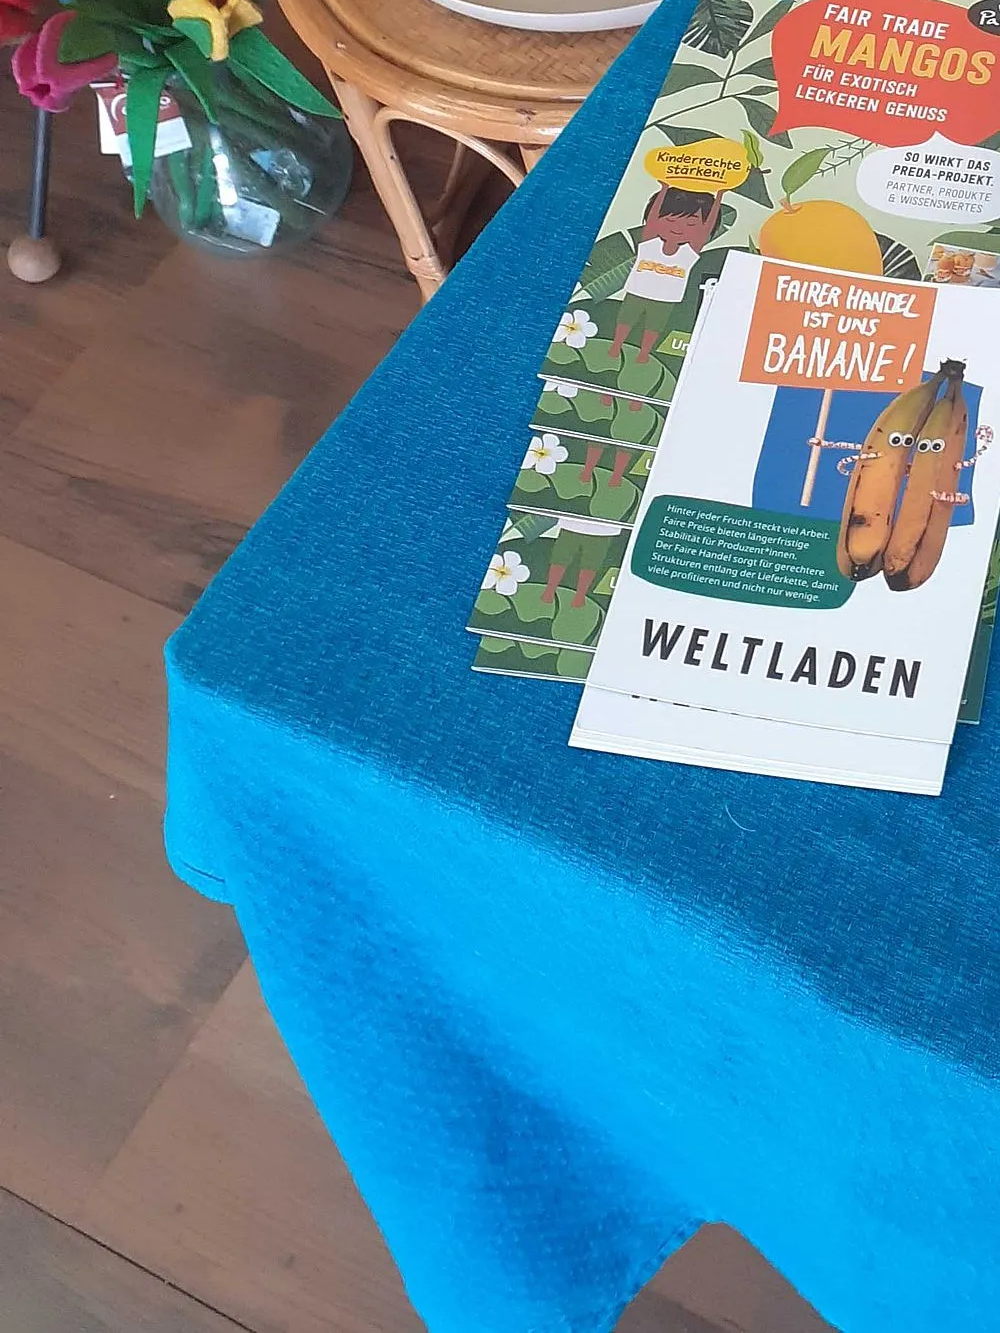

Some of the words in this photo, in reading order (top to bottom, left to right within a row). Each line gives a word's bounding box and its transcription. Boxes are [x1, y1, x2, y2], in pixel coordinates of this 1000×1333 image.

[824, 3, 872, 28] FAIR
[882, 13, 950, 40] TRADE
[809, 24, 997, 86] MANGOS
[802, 64, 835, 83] FÜR
[840, 72, 918, 98] EXOTISCH
[795, 84, 881, 113] LECKEREN
[885, 101, 949, 123] GENUSS
[656, 151, 742, 171] Kinderrechte
[666, 164, 726, 180] stärken!
[892, 165, 995, 188] PREDA-PROJEKT.
[904, 152, 920, 163] SO
[924, 154, 964, 168] WIRKT
[967, 159, 992, 172] DAS
[886, 180, 936, 196] PARTNER,
[938, 187, 993, 202] PRODUKTE
[888, 194, 896, 203] &
[900, 195, 984, 214] WISSENSWERTES
[776, 275, 842, 308] FAIRER
[845, 284, 921, 319] HANDEL
[803, 310, 835, 329] IST
[837, 315, 880, 337] UNS
[659, 528, 701, 544] Stabilität
[702, 536, 715, 547] für
[663, 516, 686, 528] Faire
[687, 521, 716, 534] Preise
[717, 527, 746, 539] bieten
[747, 532, 810, 550] längerfristige
[666, 504, 697, 517] Hinter
[696, 509, 725, 523] jeder
[722, 515, 752, 528] Frucht
[753, 521, 781, 533] steckt
[782, 525, 799, 536] viel
[799, 529, 831, 540] Arbeit.
[652, 552, 702, 570] Strukturen
[703, 562, 738, 578] entlang
[740, 567, 756, 579] der
[758, 572, 810, 589] Lieferkette,
[811, 579, 839, 592] damit
[656, 539, 673, 551] Der
[674, 544, 698, 557] Faire
[698, 549, 732, 563] Handel
[733, 555, 758, 569] sorgt
[758, 559, 772, 569] für
[774, 562, 825, 577] gerechtere
[648, 564, 671, 578] viele
[670, 569, 721, 587] profitieren
[721, 578, 741, 591] und
[742, 583, 765, 596] nicht
[767, 587, 785, 597] nur
[785, 590, 821, 603] wenige.
[641, 617, 922, 699] WELTLADEN
